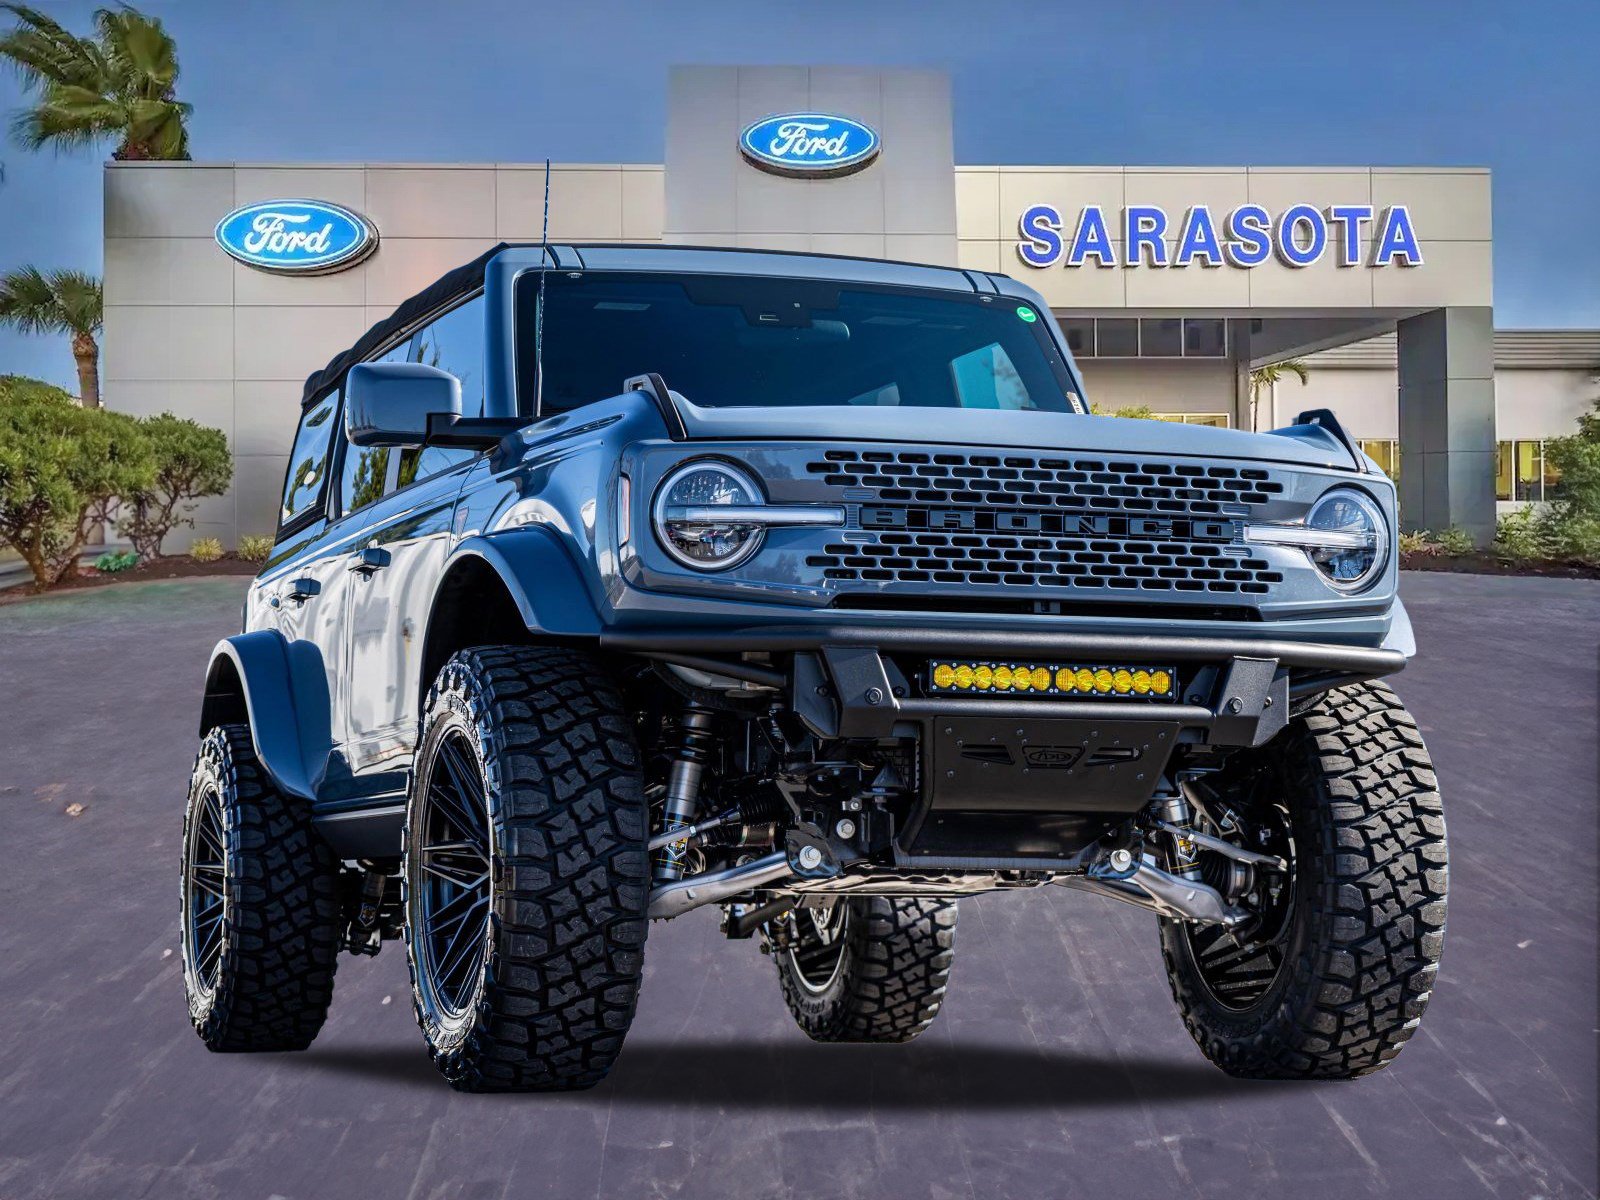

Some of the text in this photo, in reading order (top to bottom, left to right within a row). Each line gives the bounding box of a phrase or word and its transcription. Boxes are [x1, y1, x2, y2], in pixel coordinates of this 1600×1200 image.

[769, 122, 849, 156] Ford
[244, 212, 333, 254] Ford
[1017, 203, 1424, 268] SARASOTA
[859, 506, 1236, 541] BRONCO
